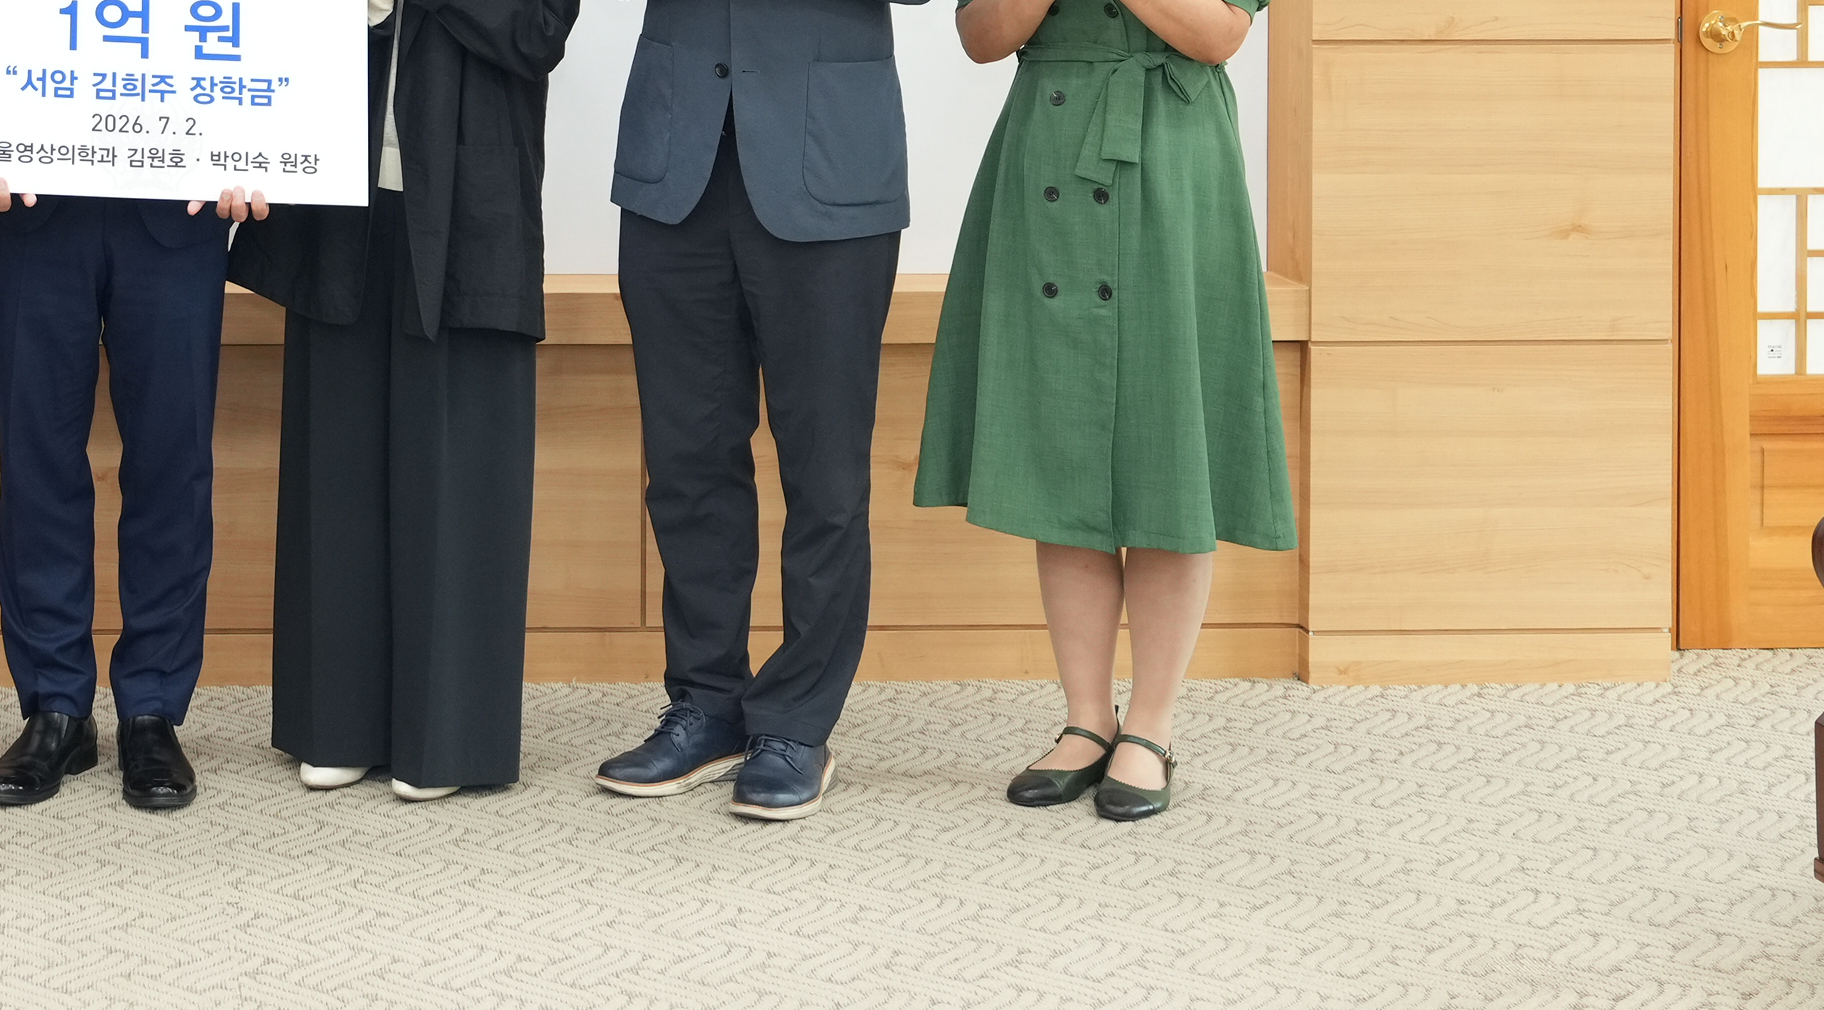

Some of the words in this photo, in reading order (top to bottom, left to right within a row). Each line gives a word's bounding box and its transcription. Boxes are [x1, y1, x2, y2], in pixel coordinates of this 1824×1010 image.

[184, 0, 241, 61] 원
[6, 65, 78, 98] “서암
[92, 72, 176, 102] 김희주
[190, 76, 289, 106] 장학금”
[92, 114, 149, 133] 2026.
[159, 117, 176, 134] 7.
[186, 118, 202, 136] 2.
[128, 148, 186, 168] 김원호
[211, 151, 270, 172] 박인숙
[280, 153, 319, 174] 원장
